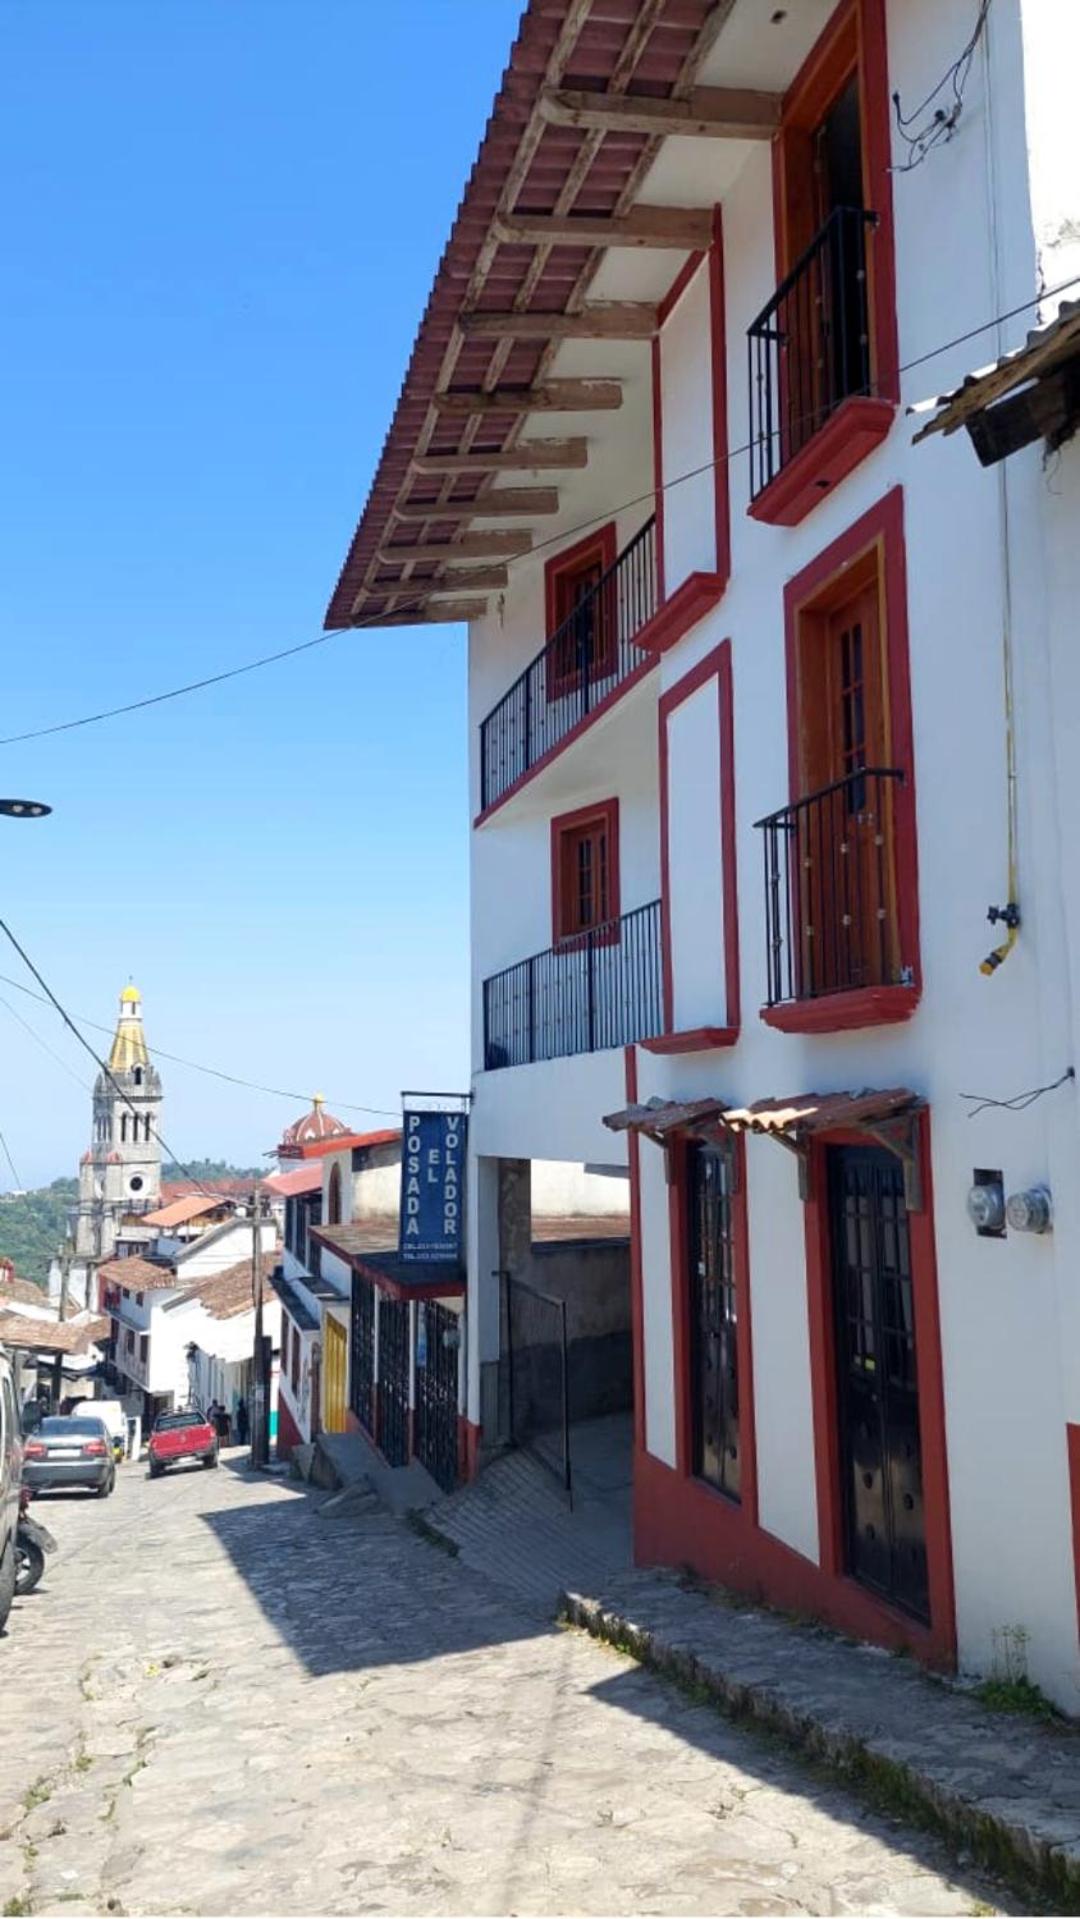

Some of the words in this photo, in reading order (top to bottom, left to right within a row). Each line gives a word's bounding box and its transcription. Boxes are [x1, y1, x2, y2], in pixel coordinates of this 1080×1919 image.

[407, 1115, 421, 1235] POSADA
[428, 1148, 440, 1183] EL
[444, 1116, 459, 1234] VOLADOR
